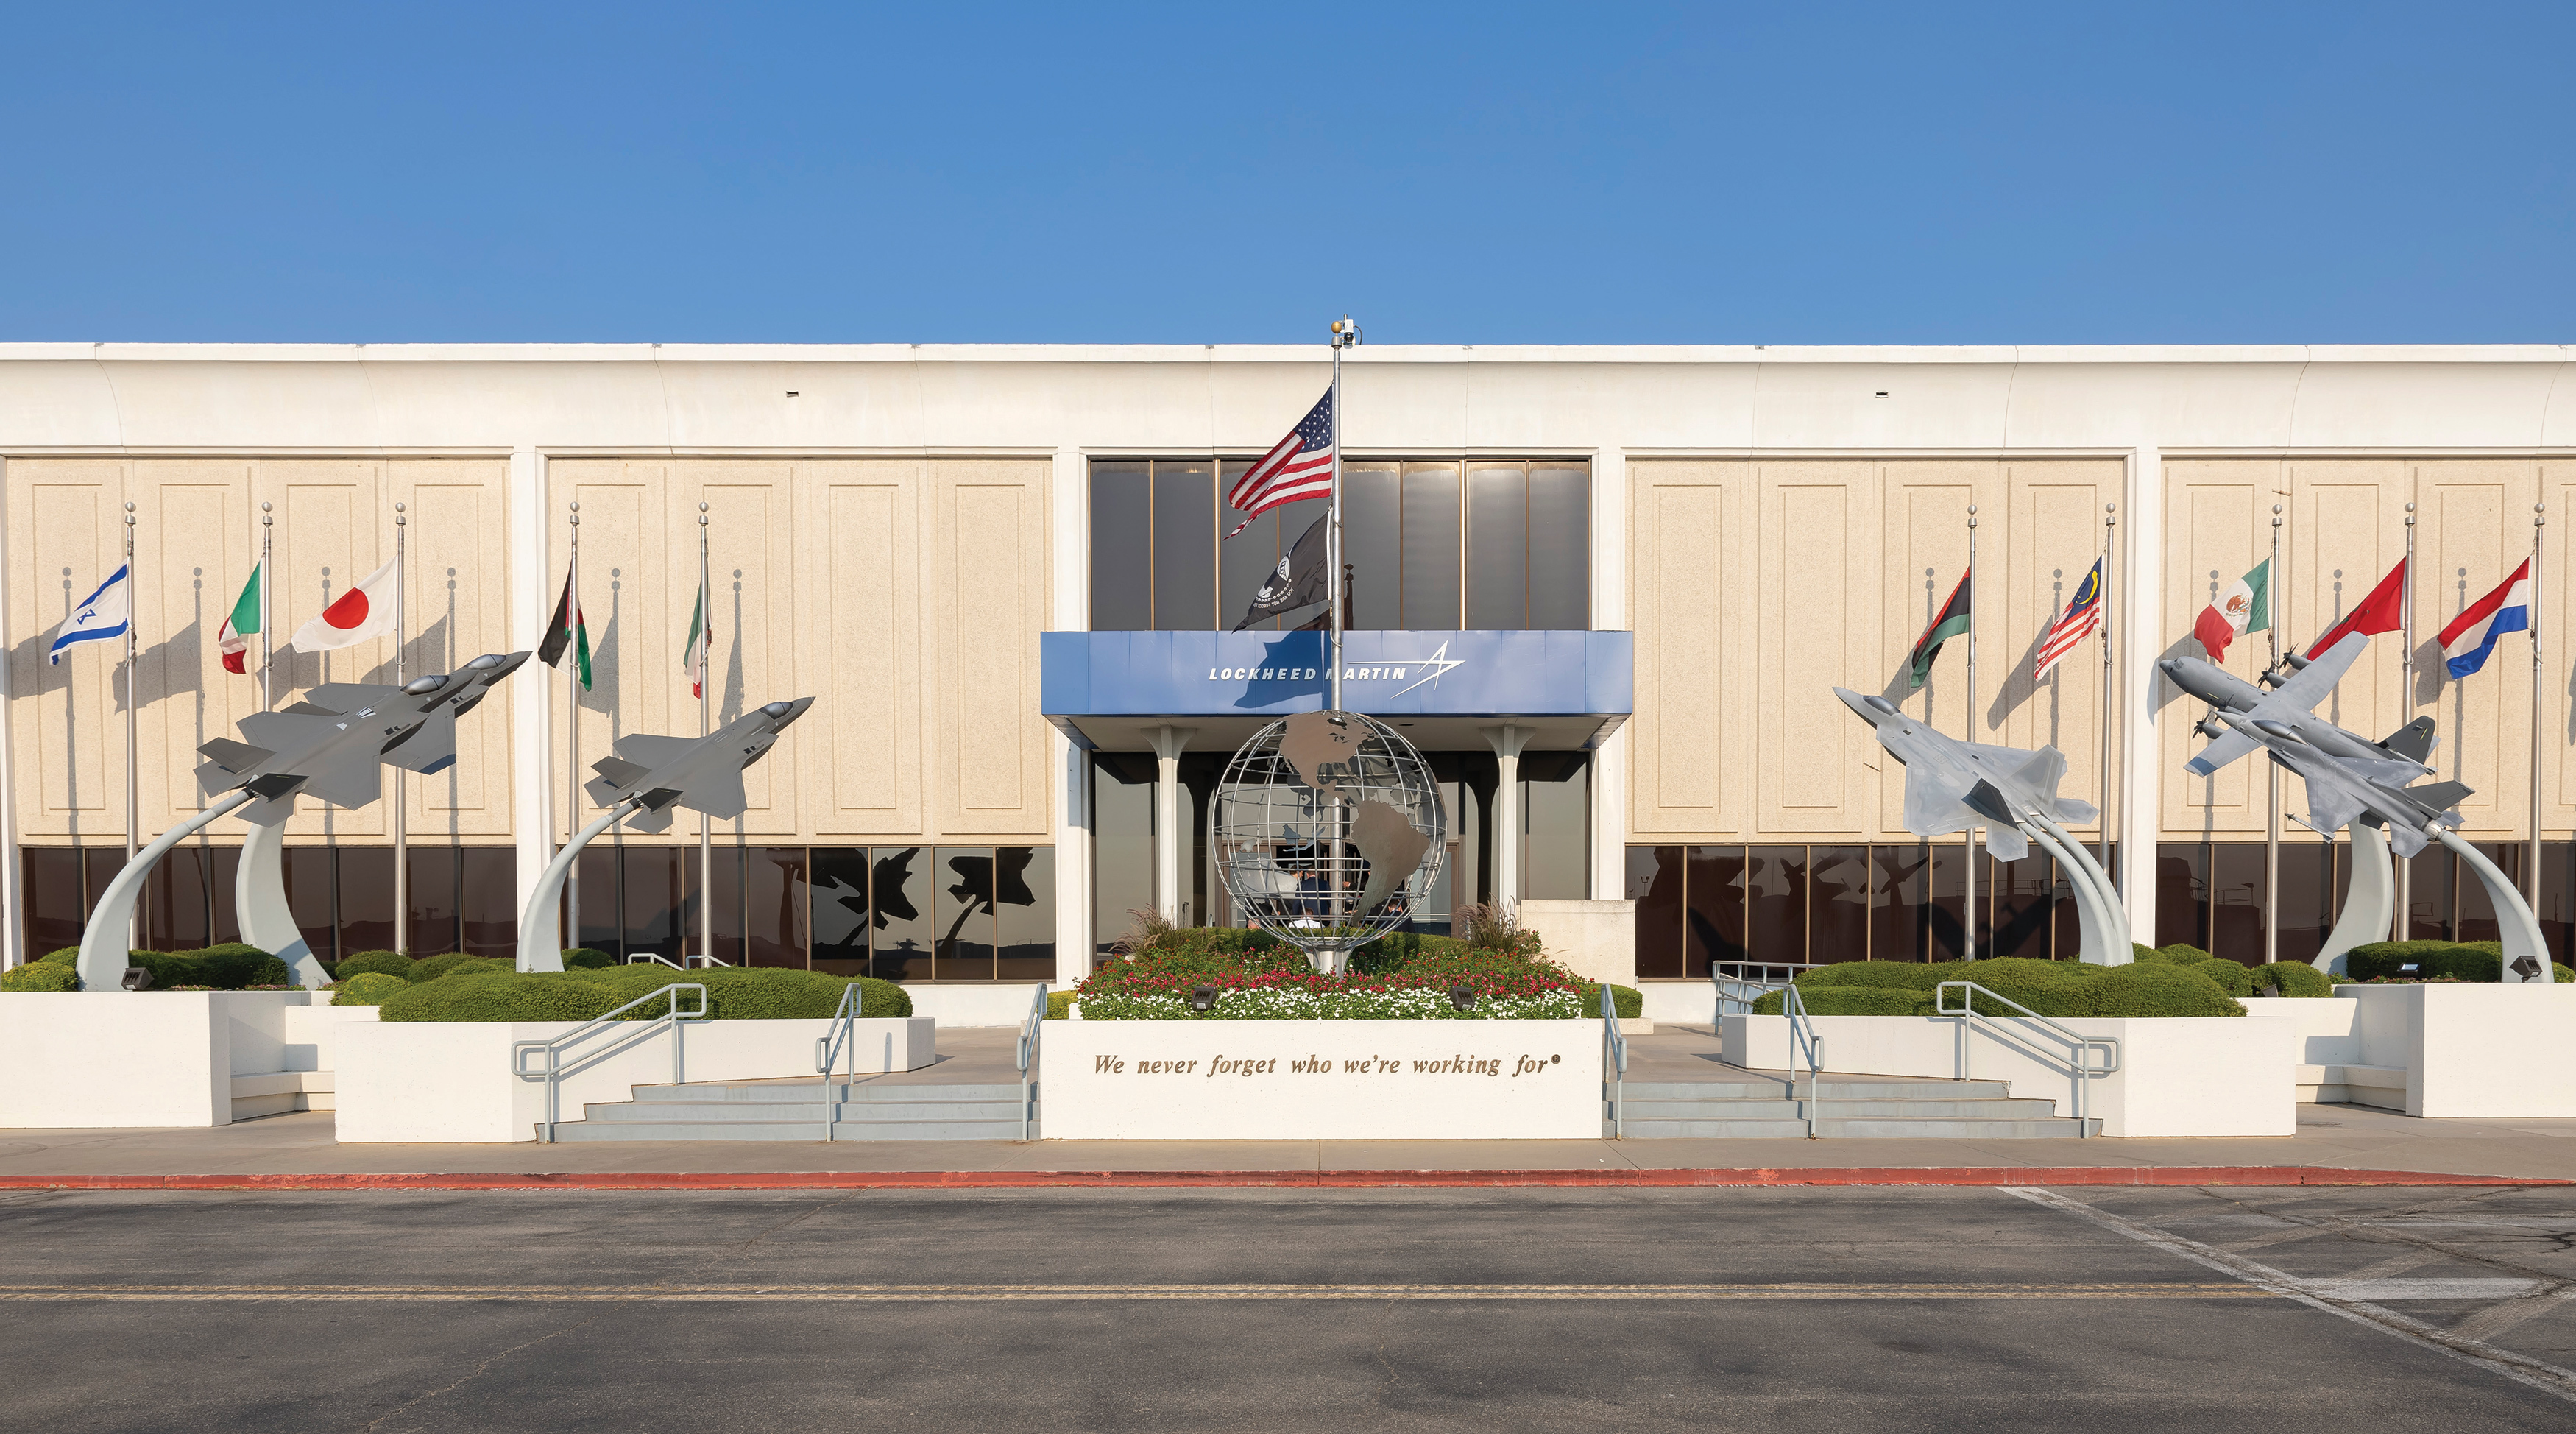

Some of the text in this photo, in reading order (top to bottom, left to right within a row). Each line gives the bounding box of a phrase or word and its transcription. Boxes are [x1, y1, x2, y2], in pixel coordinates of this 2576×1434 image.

[1209, 668, 1316, 680] LOCKHEED
[1095, 1054, 1125, 1074] We
[1137, 1060, 1197, 1074] never
[1207, 1054, 1277, 1077] forget
[1292, 1053, 1332, 1074] who
[1345, 1054, 1401, 1074] we’re
[1413, 1053, 1502, 1077] working
